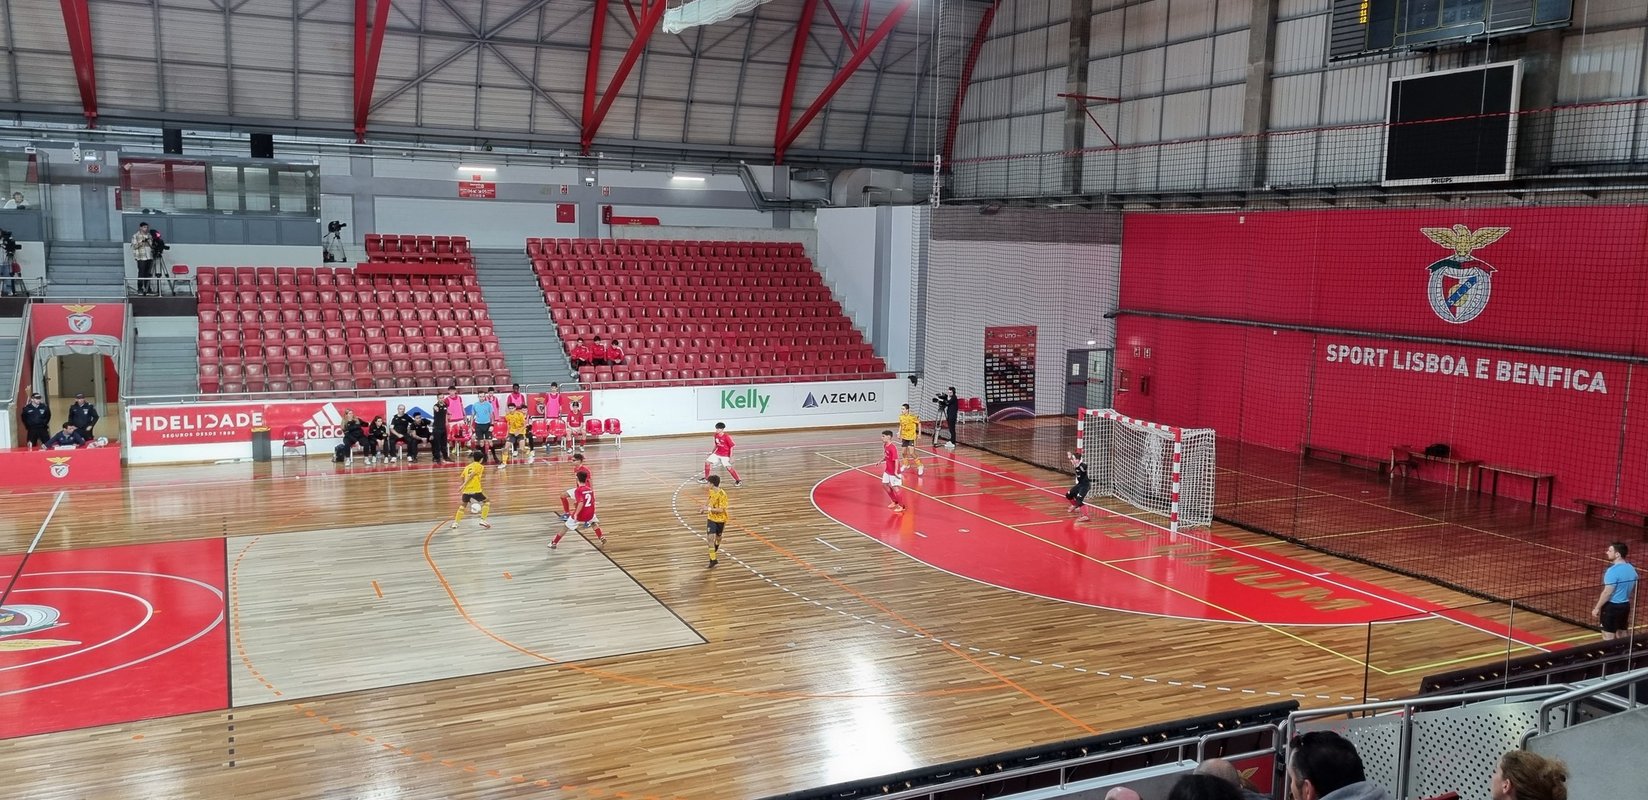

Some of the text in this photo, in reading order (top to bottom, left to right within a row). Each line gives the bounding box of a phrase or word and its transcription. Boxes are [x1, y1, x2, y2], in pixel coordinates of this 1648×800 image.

[1326, 344, 1607, 394] SPORT LISBOA E BENFICA
[721, 388, 770, 413] Kelly
[821, 392, 877, 404] AZEMAD
[131, 412, 263, 431] FIDELIDADE
[303, 425, 345, 439] dida
[584, 493, 592, 507] 2
